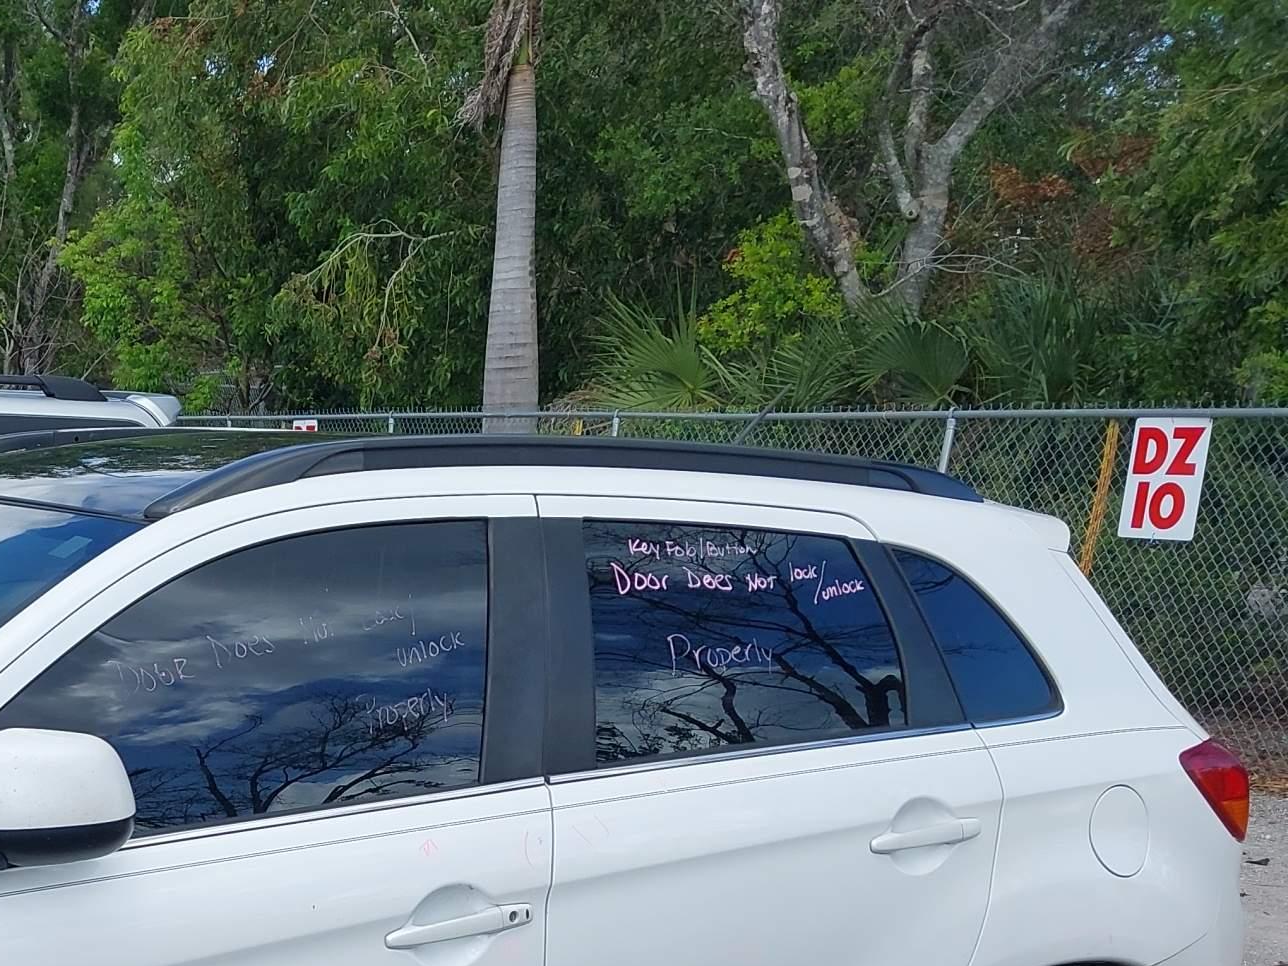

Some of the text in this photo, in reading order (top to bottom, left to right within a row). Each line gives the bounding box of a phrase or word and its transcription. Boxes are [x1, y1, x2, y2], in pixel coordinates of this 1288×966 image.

[1132, 426, 1207, 476] DZ
[1130, 481, 1186, 531] 10
[628, 538, 660, 560] Key
[667, 633, 774, 678] Properly
